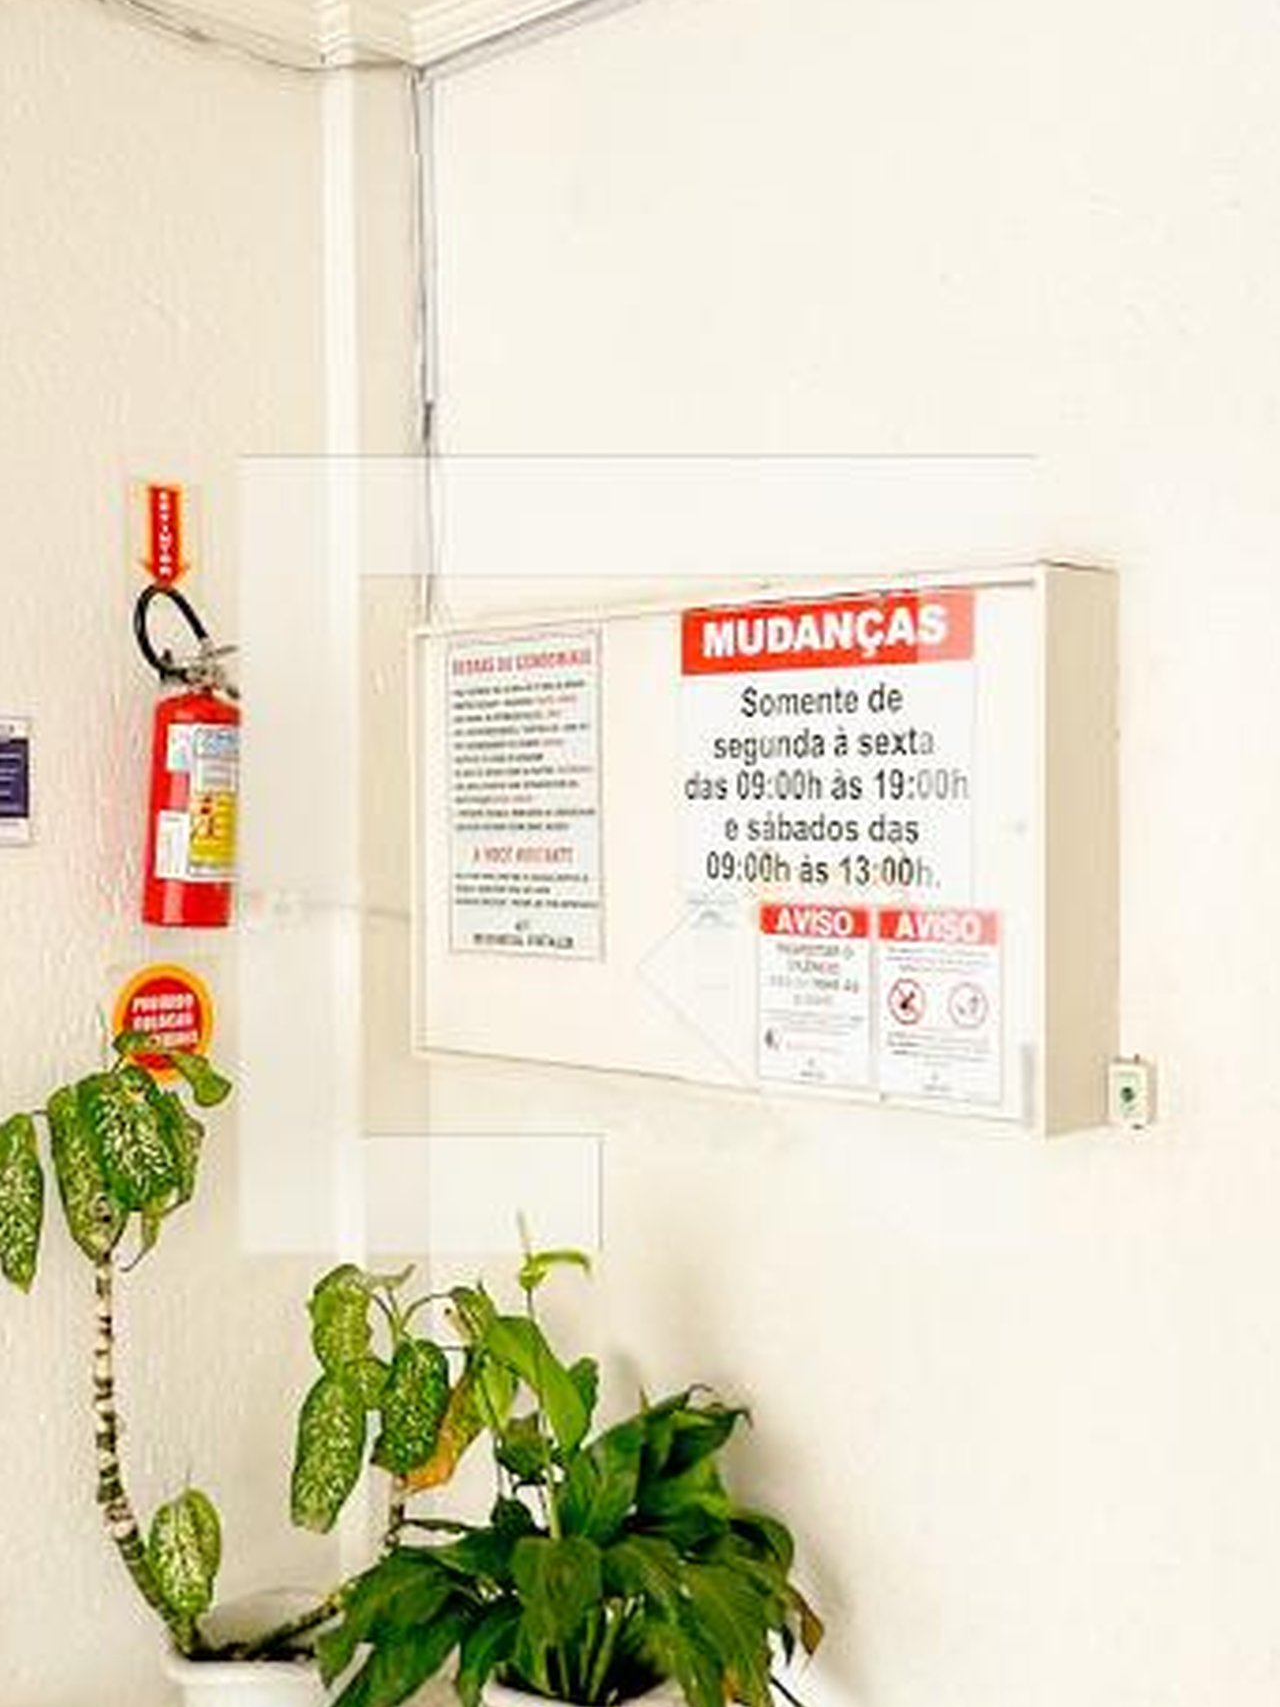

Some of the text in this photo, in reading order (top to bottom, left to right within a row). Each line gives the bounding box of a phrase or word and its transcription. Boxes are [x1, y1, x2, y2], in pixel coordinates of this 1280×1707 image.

[702, 604, 949, 658] MUDANÇAS
[740, 682, 904, 718] Somente de
[713, 728, 825, 766] segunda
[857, 727, 935, 757] sexta
[684, 768, 969, 801] das 09:00h às 19:00h
[724, 811, 920, 844] e sábados das
[706, 850, 791, 882] 09:00h
[799, 854, 830, 885] às
[776, 907, 854, 936] AVISO
[893, 911, 982, 944] AVISO
